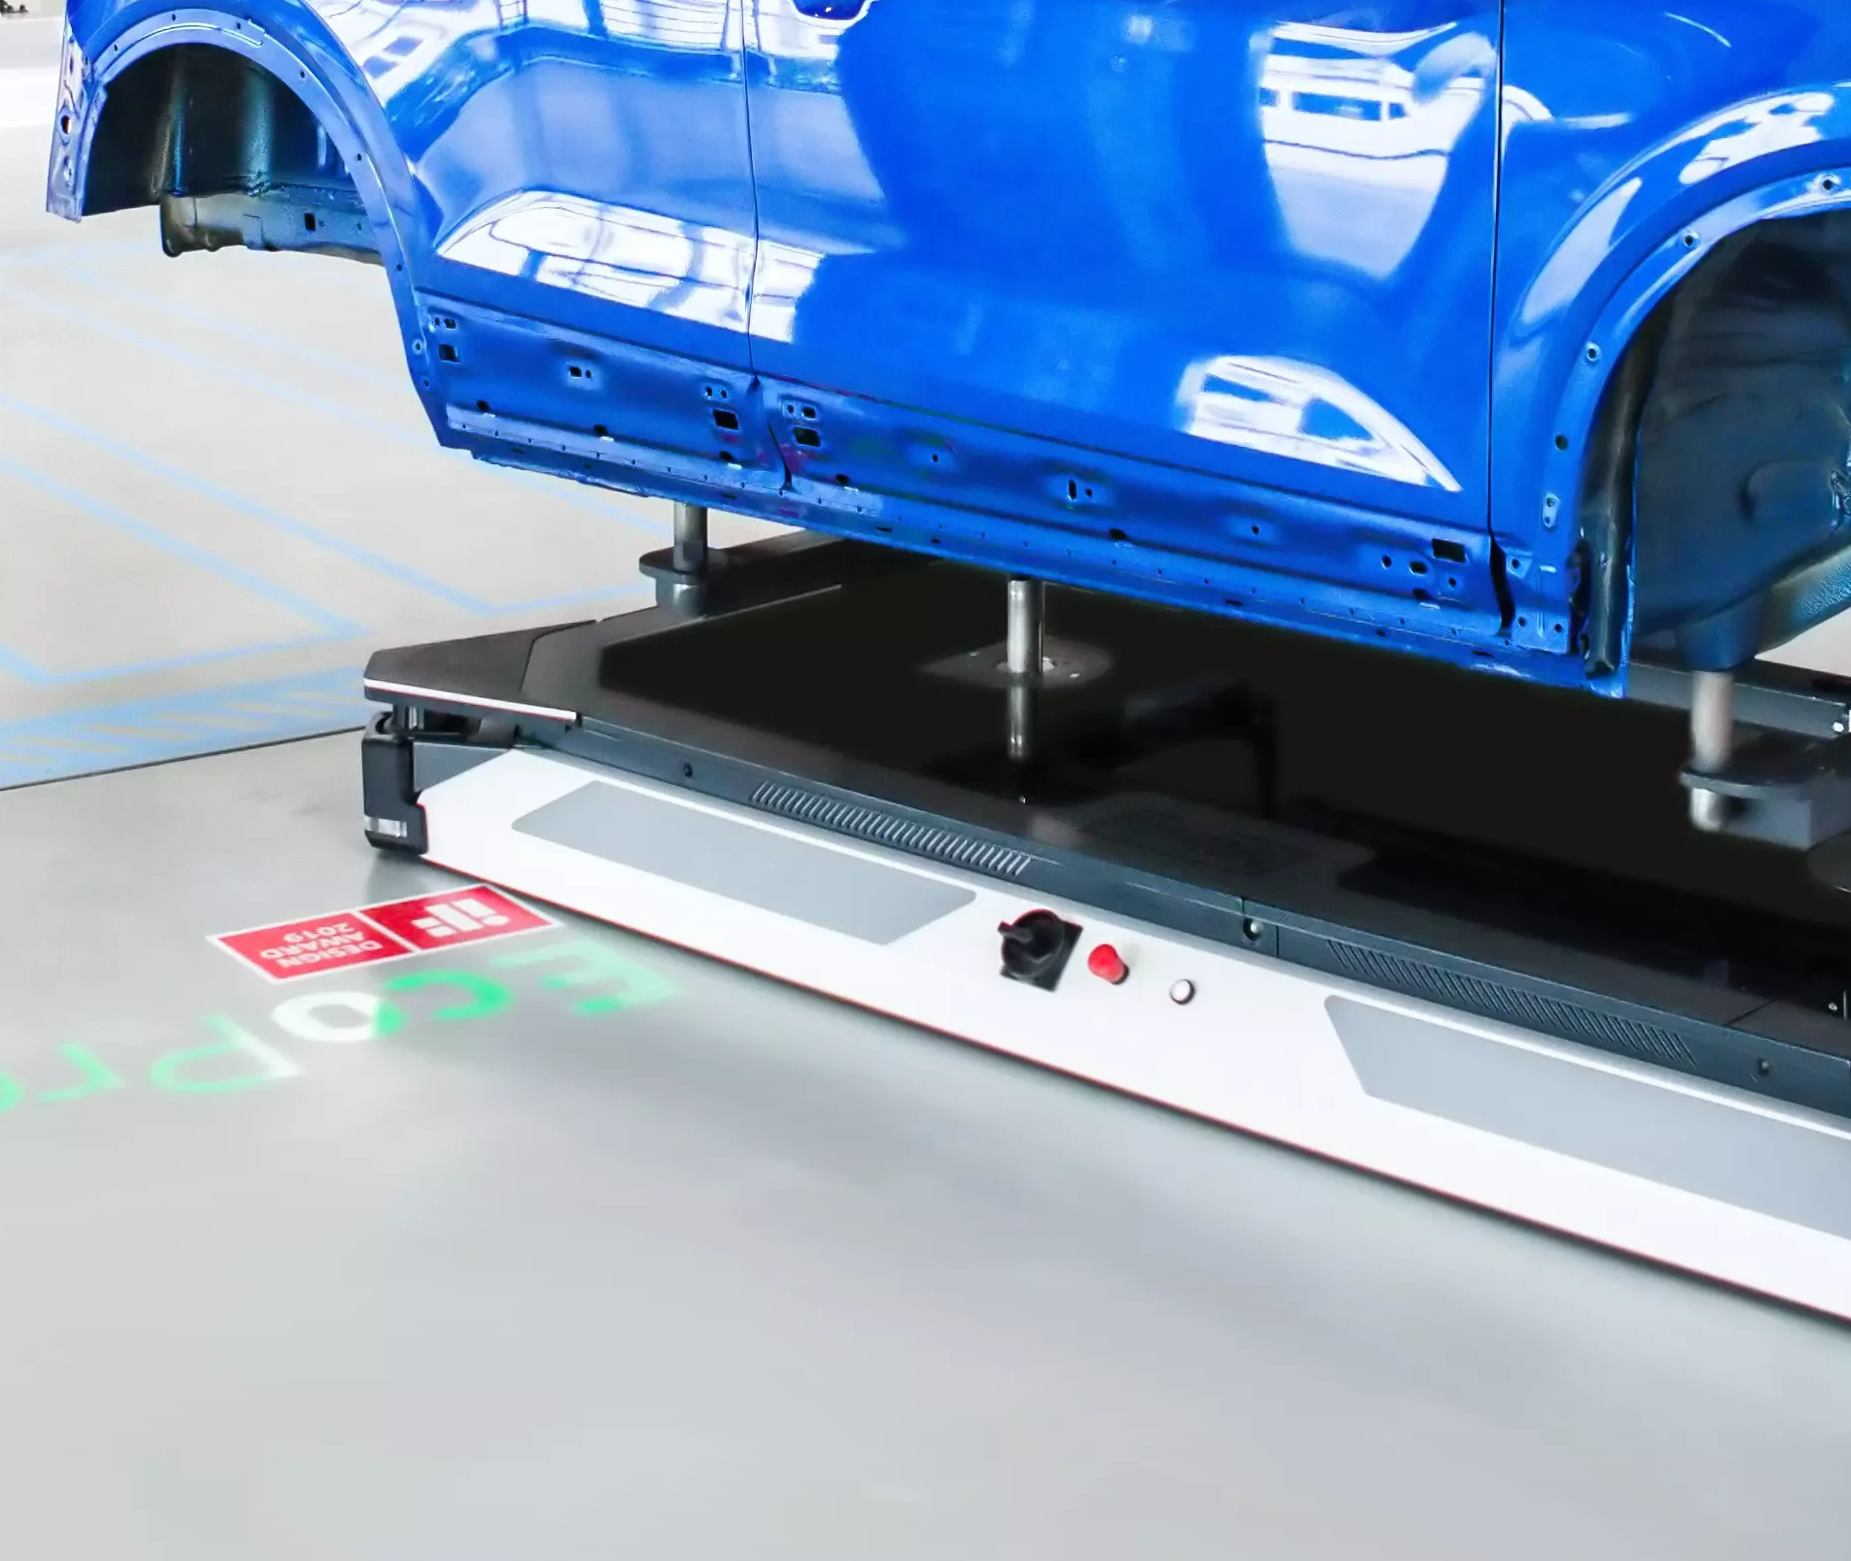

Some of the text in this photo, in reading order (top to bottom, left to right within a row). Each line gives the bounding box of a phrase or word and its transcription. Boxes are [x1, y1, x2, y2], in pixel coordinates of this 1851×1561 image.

[259, 930, 365, 959] AWARD
[282, 921, 355, 943] 2019
[274, 941, 383, 968] DESIGN
